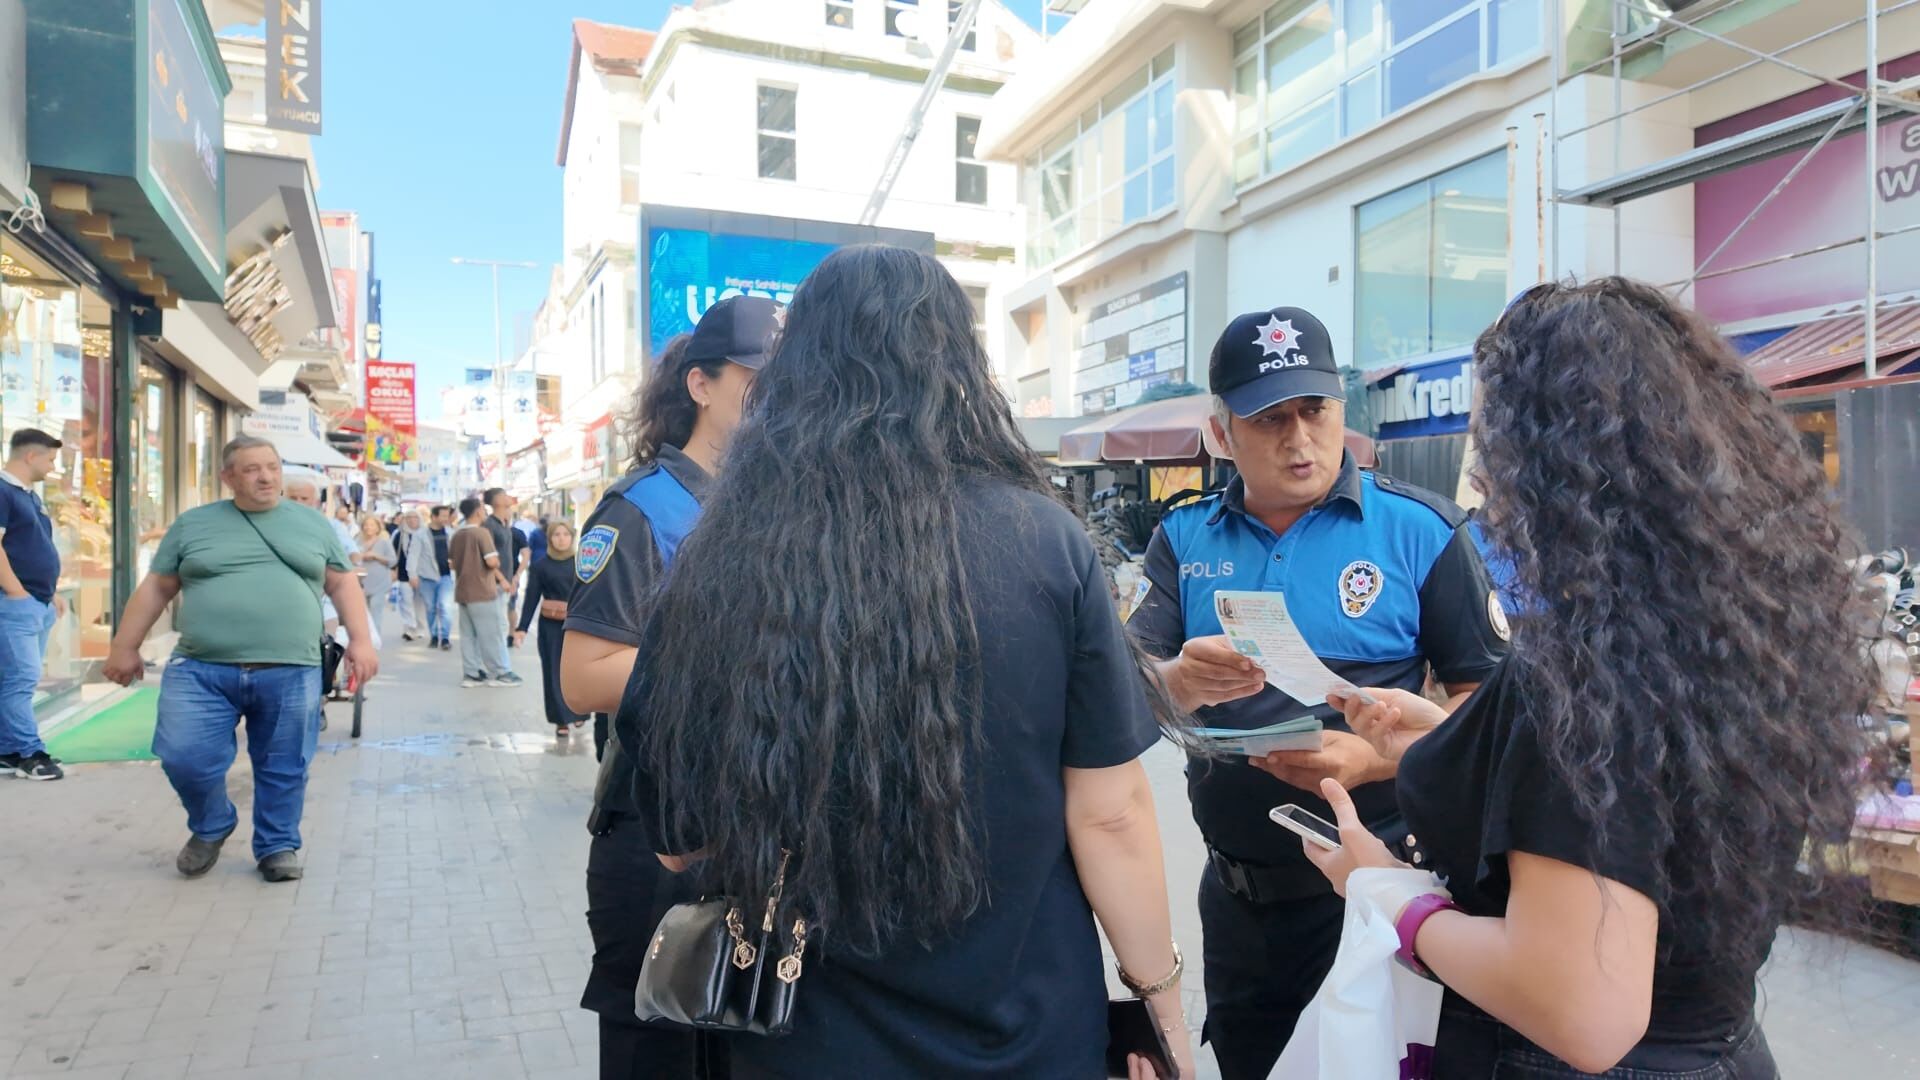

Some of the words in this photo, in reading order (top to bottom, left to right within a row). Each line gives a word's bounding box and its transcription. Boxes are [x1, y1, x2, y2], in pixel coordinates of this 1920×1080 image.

[1258, 353, 1309, 373] POLİS
[370, 387, 411, 398] OKUL
[1180, 558, 1234, 579] POLİS
[1352, 562, 1376, 573] POLİS
